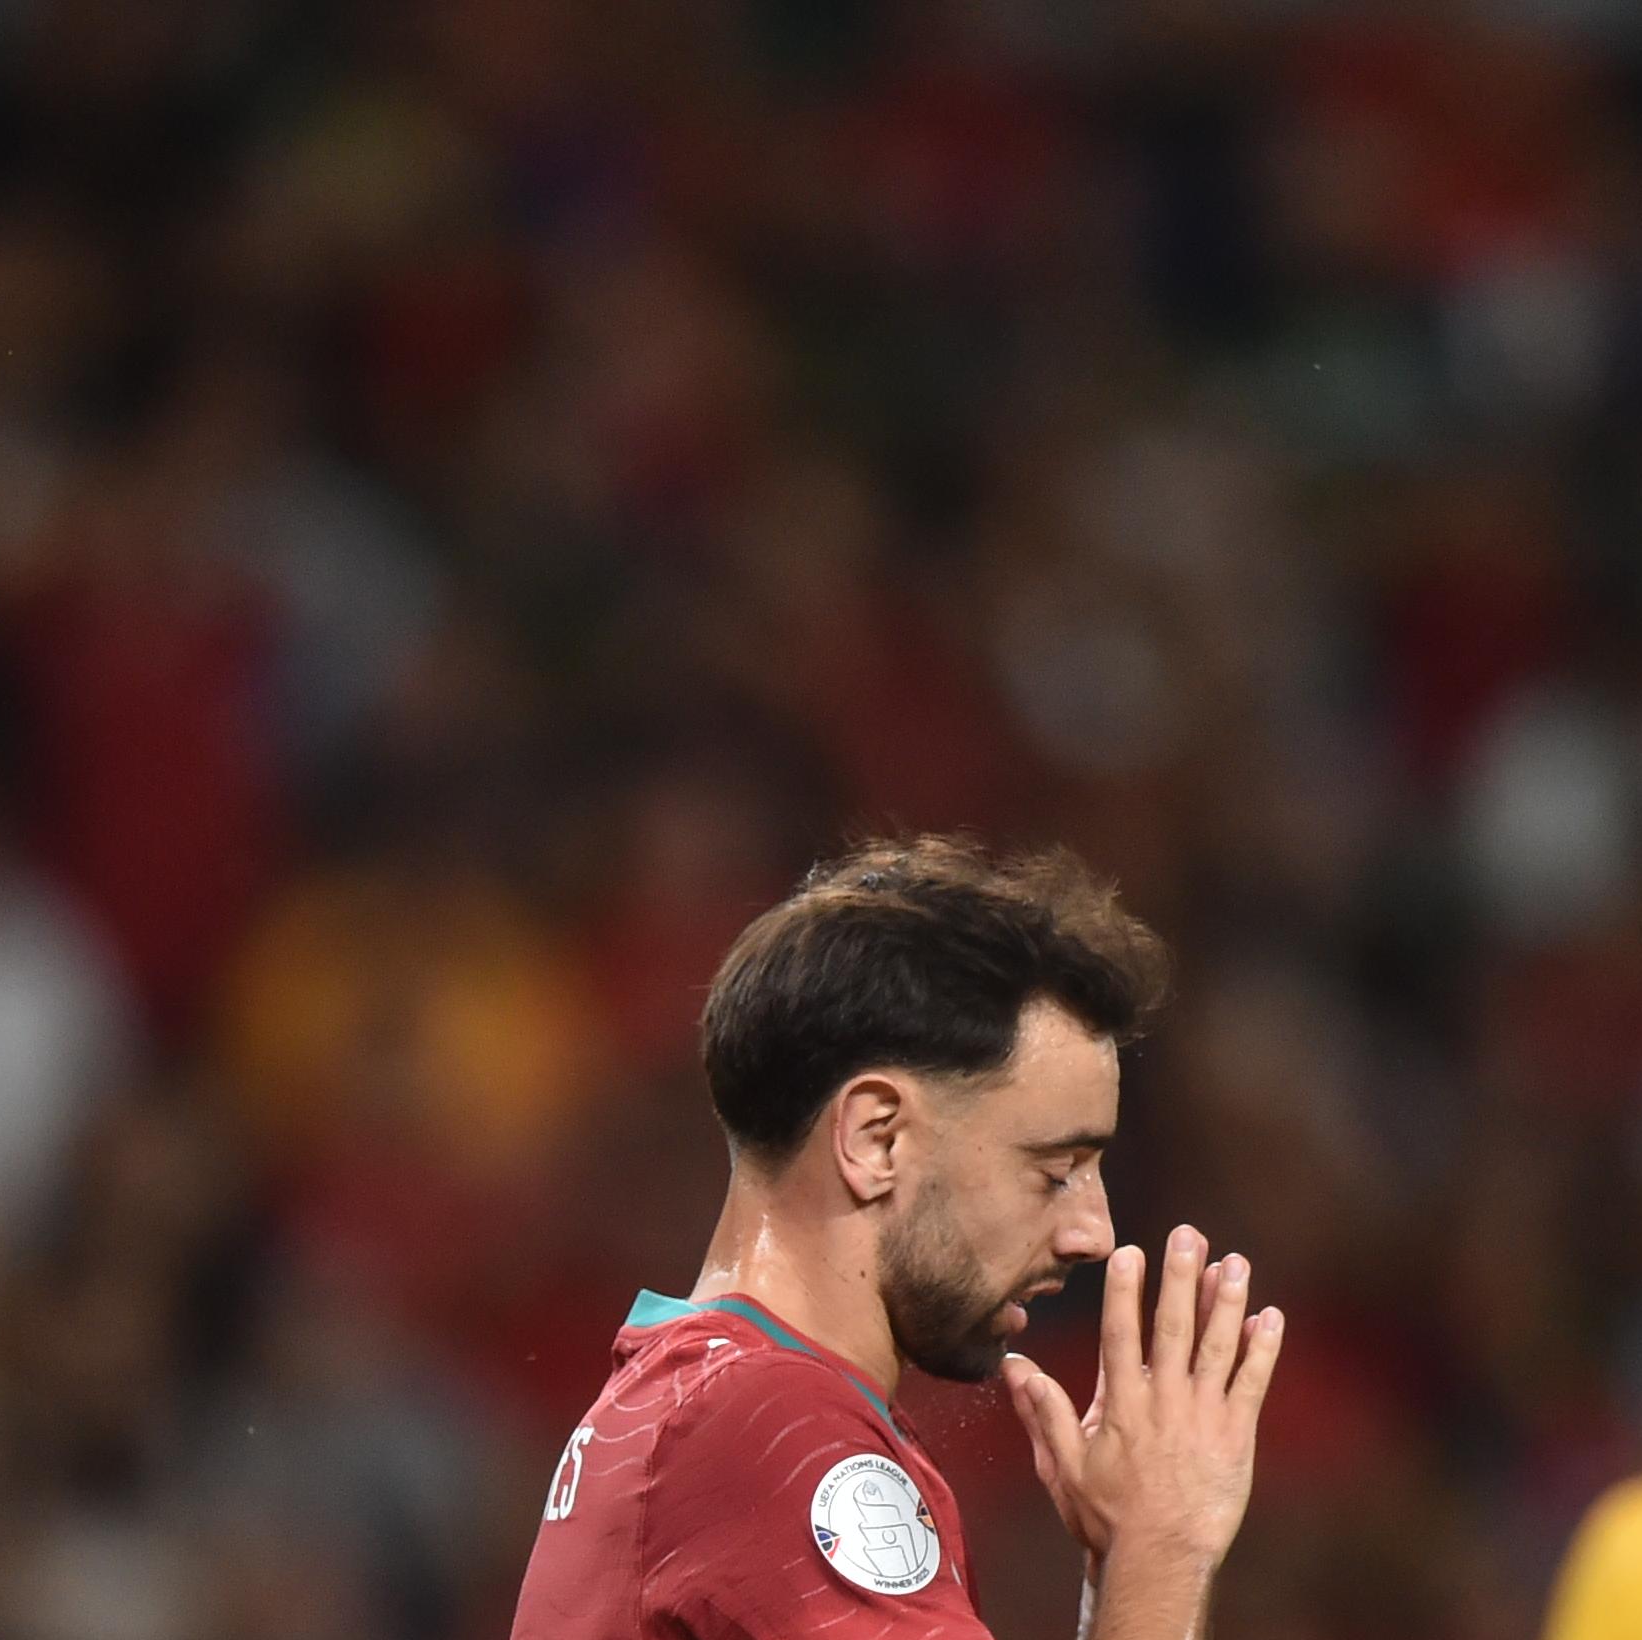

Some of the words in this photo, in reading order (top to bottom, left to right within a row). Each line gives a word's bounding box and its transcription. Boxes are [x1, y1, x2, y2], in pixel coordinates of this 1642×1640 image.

[818, 1484, 835, 1508] UEFA
[832, 1459, 874, 1483] NATIONS
[875, 1460, 909, 1487] LEAGUE
[873, 1577, 913, 1589] WINNER
[913, 1567, 931, 1585] 2025
